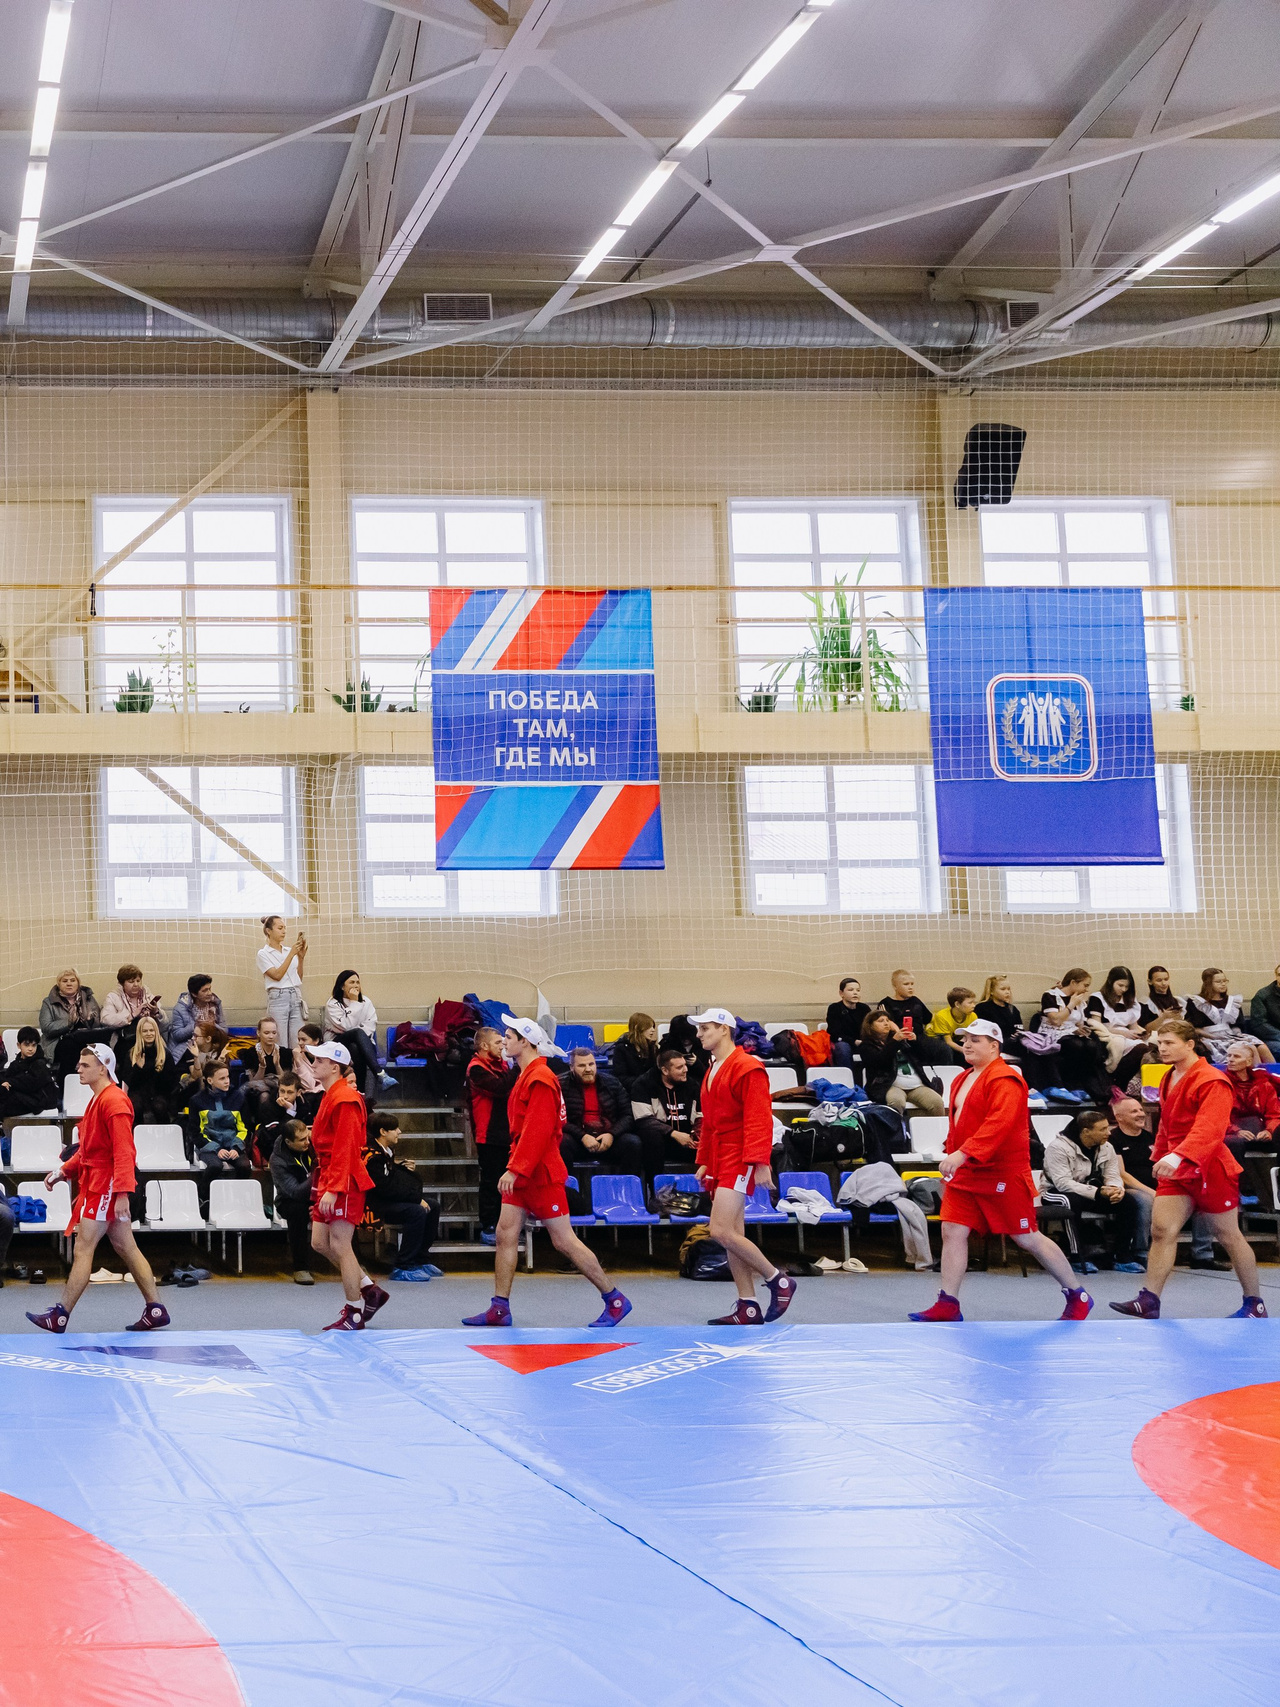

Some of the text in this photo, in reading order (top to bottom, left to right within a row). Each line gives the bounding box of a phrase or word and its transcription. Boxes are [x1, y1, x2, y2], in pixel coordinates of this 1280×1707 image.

[488, 690, 599, 713] ПОБЕДА
[512, 718, 575, 741] ТАМ,
[494, 747, 596, 770] ГДЕ МЫ
